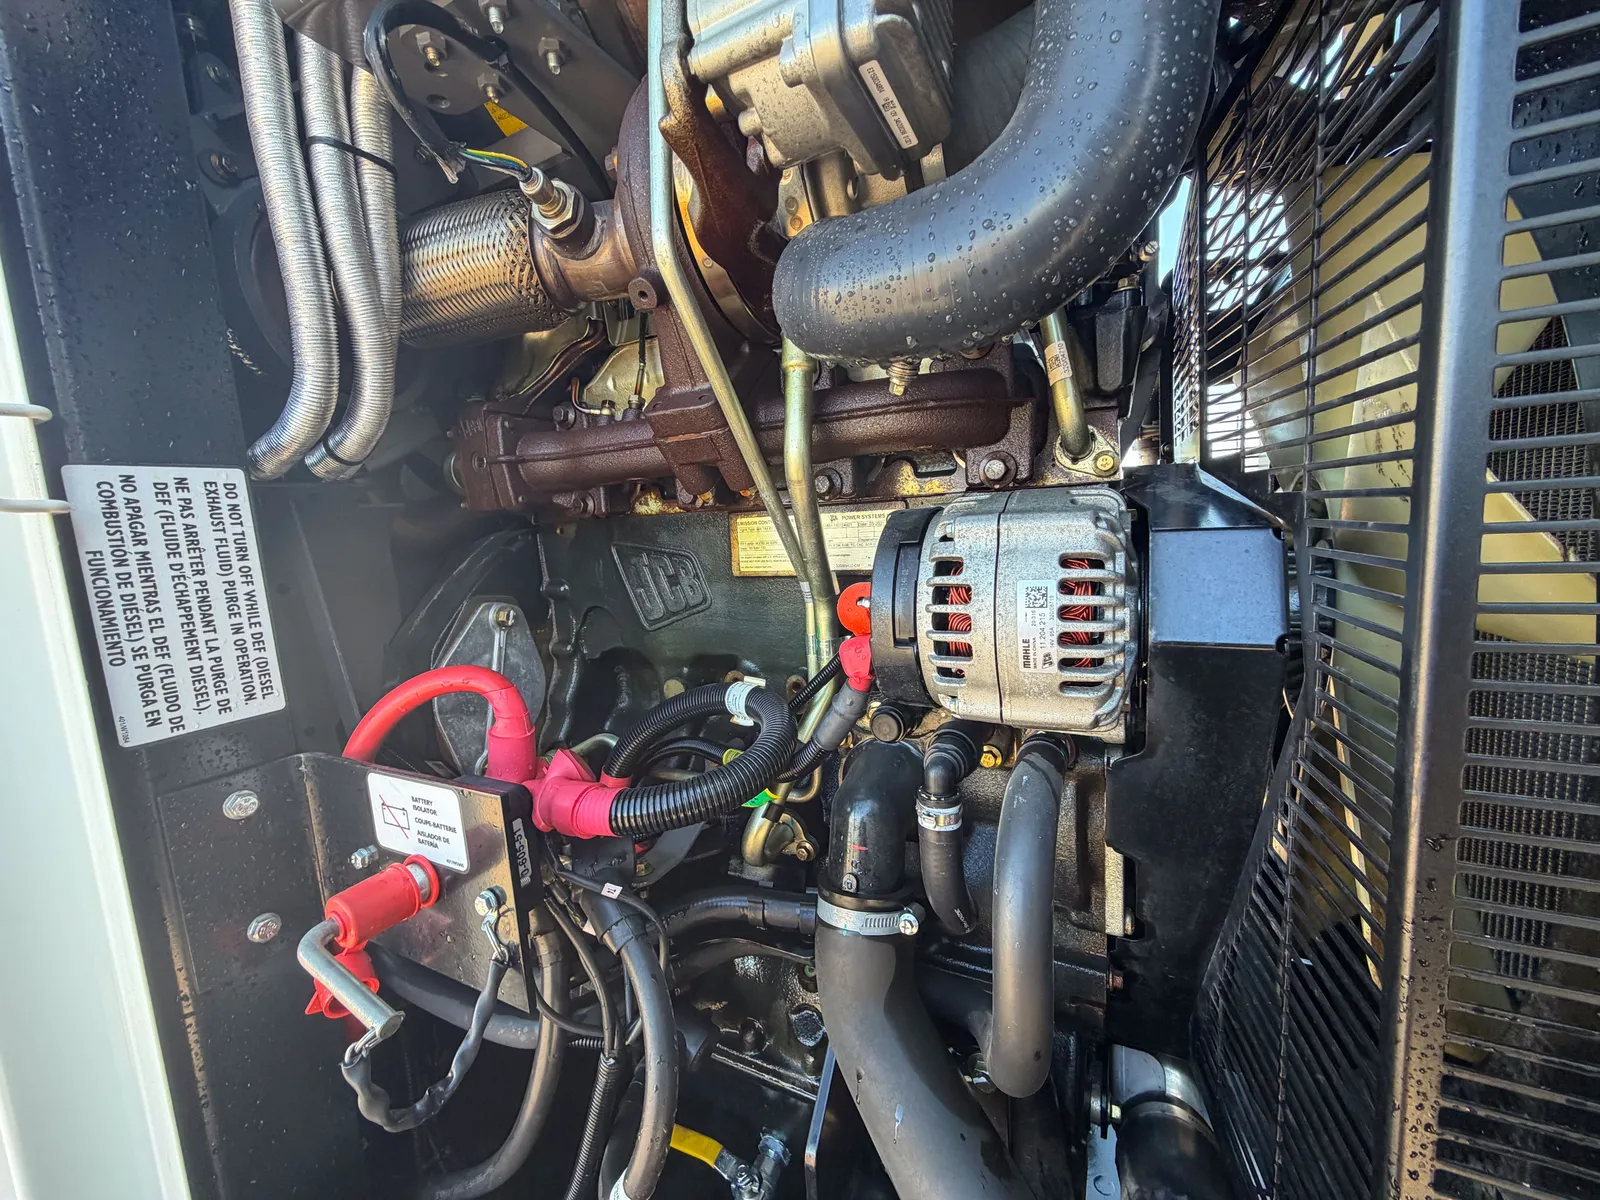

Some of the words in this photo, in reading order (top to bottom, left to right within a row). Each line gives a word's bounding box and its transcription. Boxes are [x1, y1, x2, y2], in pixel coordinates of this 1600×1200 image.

[119, 475, 137, 493] NO
[153, 482, 171, 506] DEF
[173, 477, 190, 494] NE
[223, 483, 238, 500] DO
[177, 498, 195, 520] PAS
[204, 481, 227, 533] EXHAUST
[227, 504, 242, 527] NOT
[97, 481, 132, 568] COMBUSTIÓN
[123, 497, 148, 547] APAGAR
[154, 510, 181, 559] (FLUIDE
[181, 523, 206, 576] ARRÊTER
[214, 538, 233, 577] FLUID)
[232, 531, 247, 561] TURN
[116, 572, 133, 590] DE
[134, 551, 161, 613] MIENTRAS
[238, 566, 252, 586] OFF
[629, 552, 704, 620] JCB
[86, 550, 126, 667] FUNCIONAMIENTO
[171, 563, 202, 661] D'ÉCHAPPEMENT
[193, 581, 216, 634] PENDANT
[221, 581, 241, 619] PURGE
[242, 590, 261, 628] WHILE
[120, 594, 145, 643] DIÉSEL)
[150, 618, 165, 633] EL
[230, 623, 244, 635] IN
[130, 646, 146, 661] SE
[152, 636, 171, 659] DEF
[205, 638, 220, 653] LA
[252, 632, 266, 653] DEF
[1022, 639, 1031, 668] MAHLE
[208, 657, 229, 695] PURGE
[233, 639, 257, 706] OPERATION.
[252, 657, 274, 699] (DIESEL
[135, 666, 158, 707] PURGA
[153, 664, 181, 713] (FLUIDO
[188, 666, 211, 715] DIESEL).
[145, 711, 162, 727] EN
[217, 699, 232, 714] DE
[169, 716, 185, 733] DE
[411, 796, 433, 806] BATTERY
[412, 805, 437, 816] ISOLATOR
[415, 817, 457, 833] COUPE-BATTERIE
[417, 830, 441, 842] AISLADOR
[418, 838, 439, 849] BATERÍA
